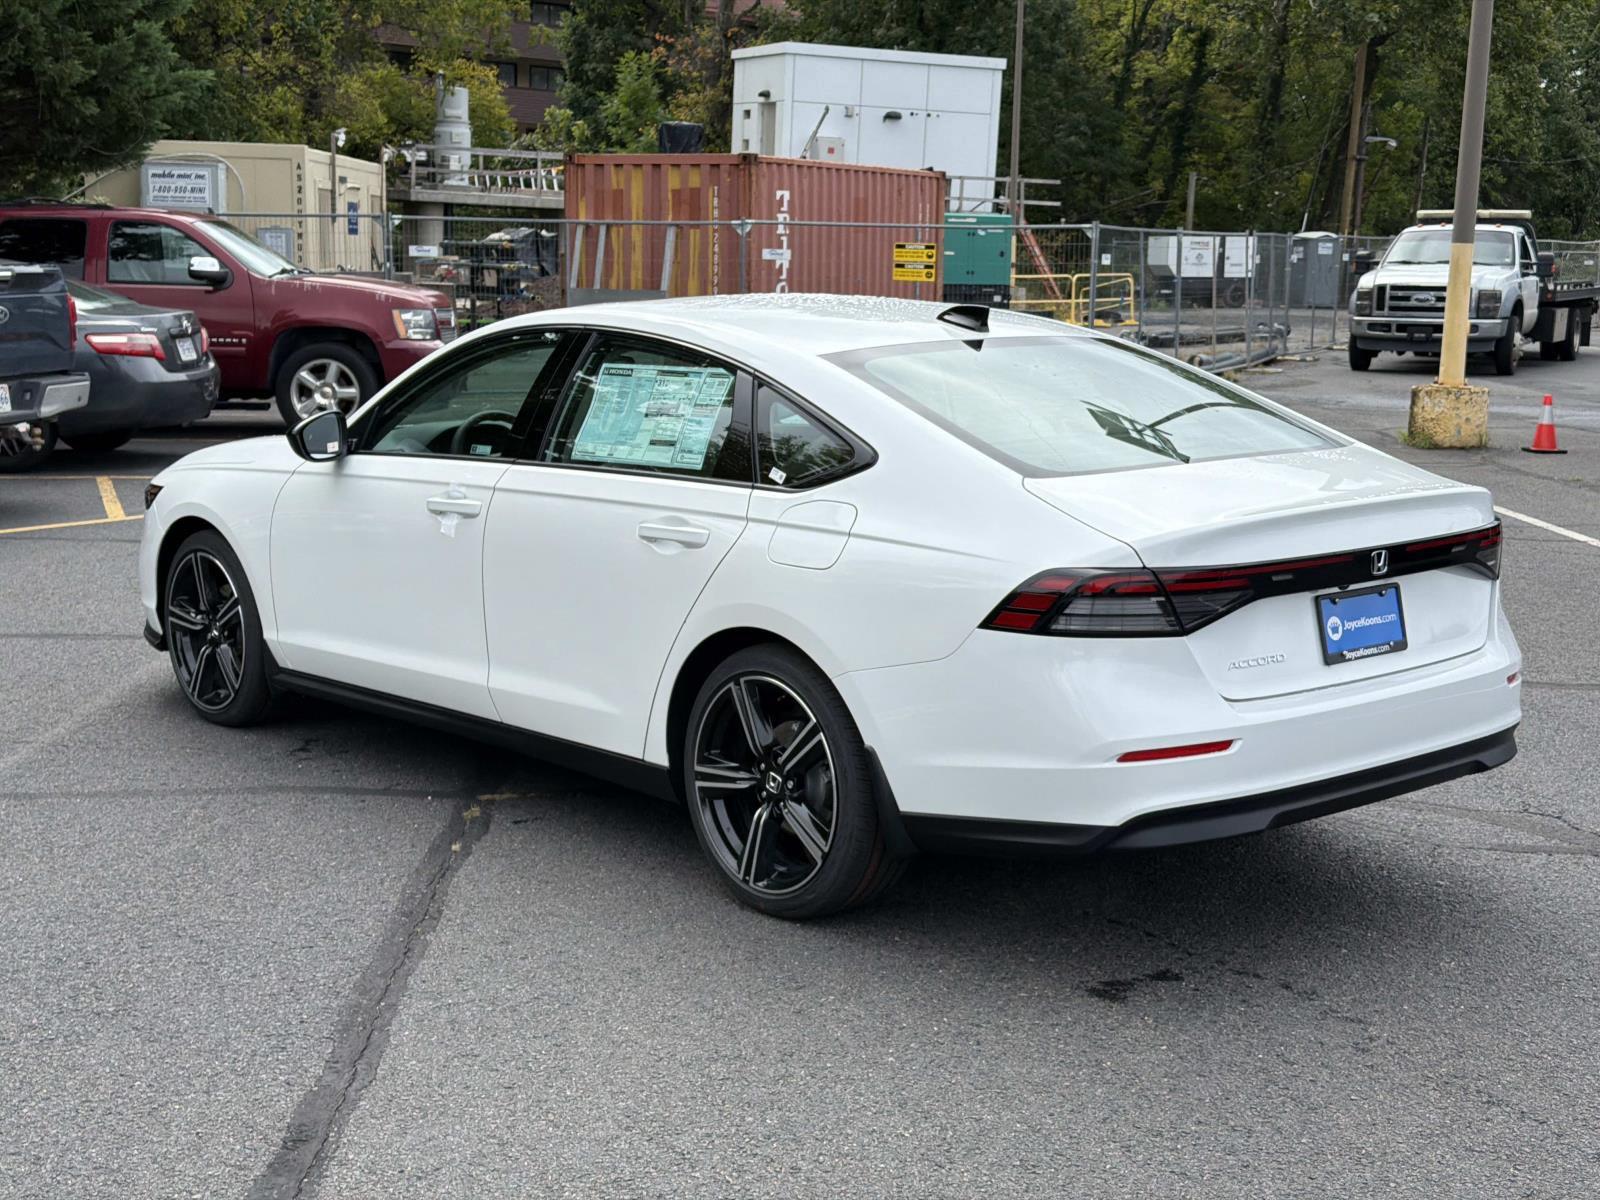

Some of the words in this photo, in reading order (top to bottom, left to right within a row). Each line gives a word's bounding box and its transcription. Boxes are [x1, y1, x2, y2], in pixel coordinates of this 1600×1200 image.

[151, 169, 175, 179] mobile
[1343, 613, 1397, 631] JoyceKoons.com
[1344, 644, 1390, 660] JoyceKoons.com
[1228, 653, 1287, 671] ACCORD
